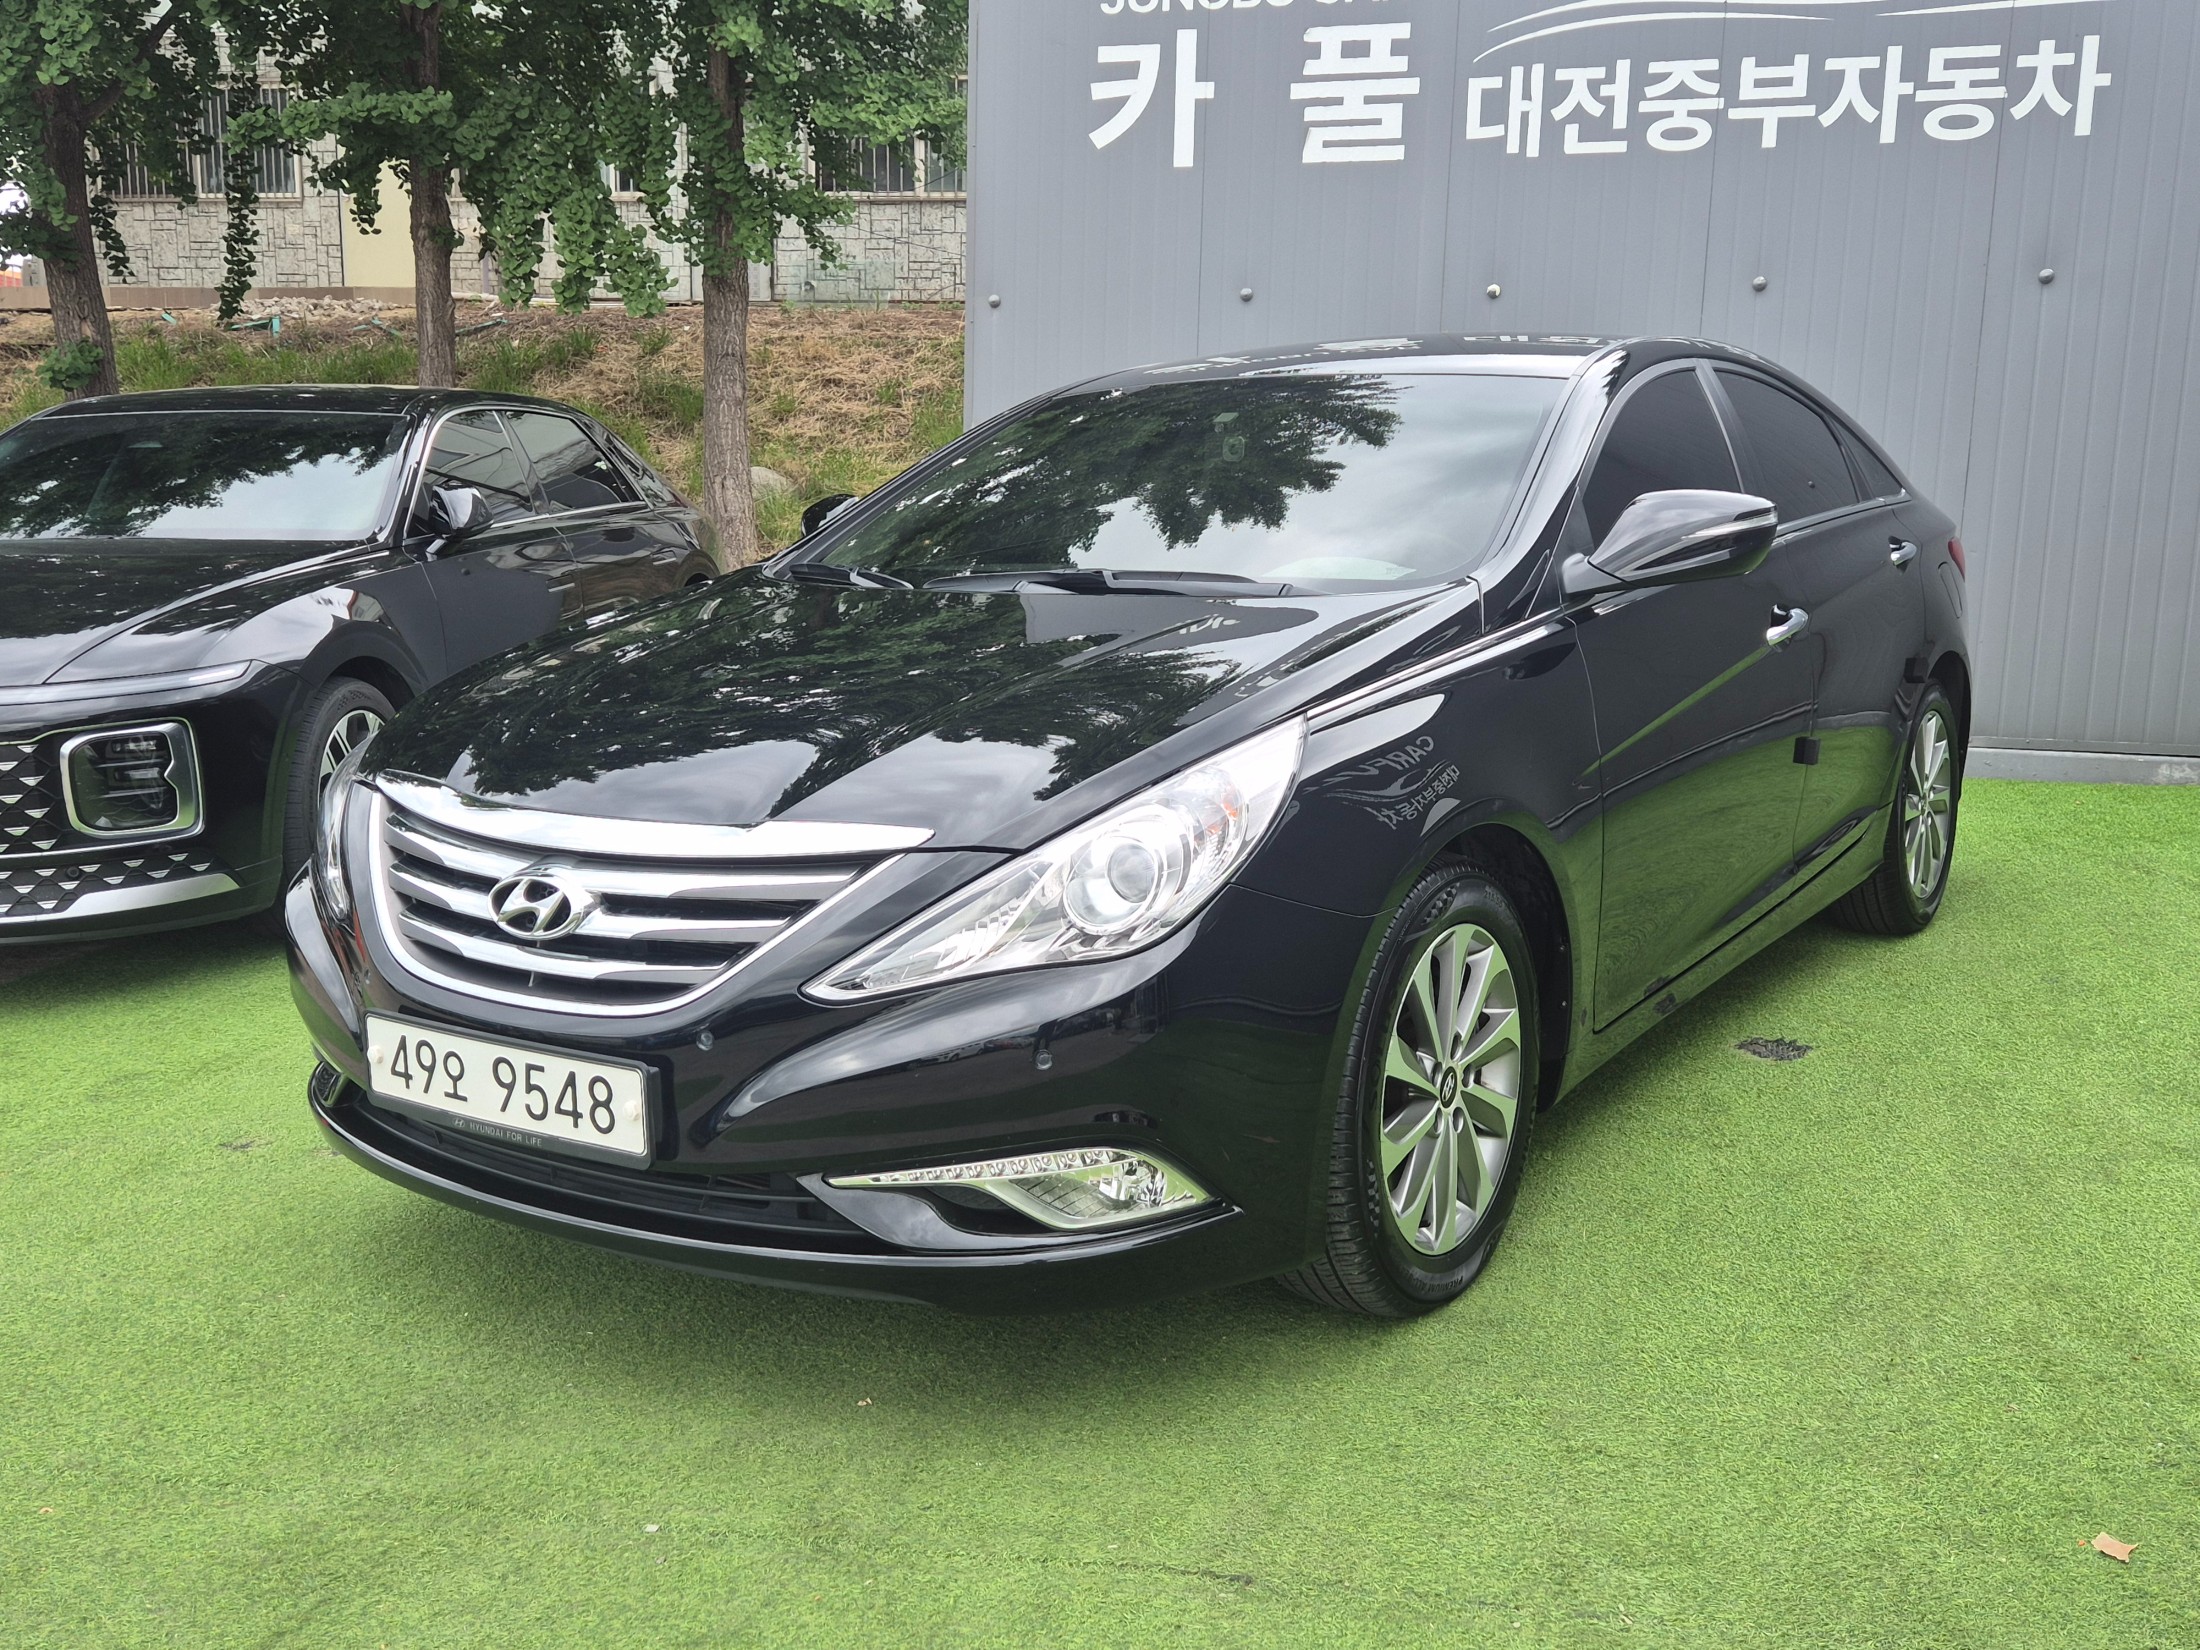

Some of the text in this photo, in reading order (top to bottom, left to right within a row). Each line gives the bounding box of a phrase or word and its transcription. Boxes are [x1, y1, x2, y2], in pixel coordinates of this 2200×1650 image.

[1465, 35, 2112, 158] 대전중부자동차
[390, 1034, 615, 1135] 49오 9548
[469, 1121, 542, 1147] HYUNDAI FOR LIFE
